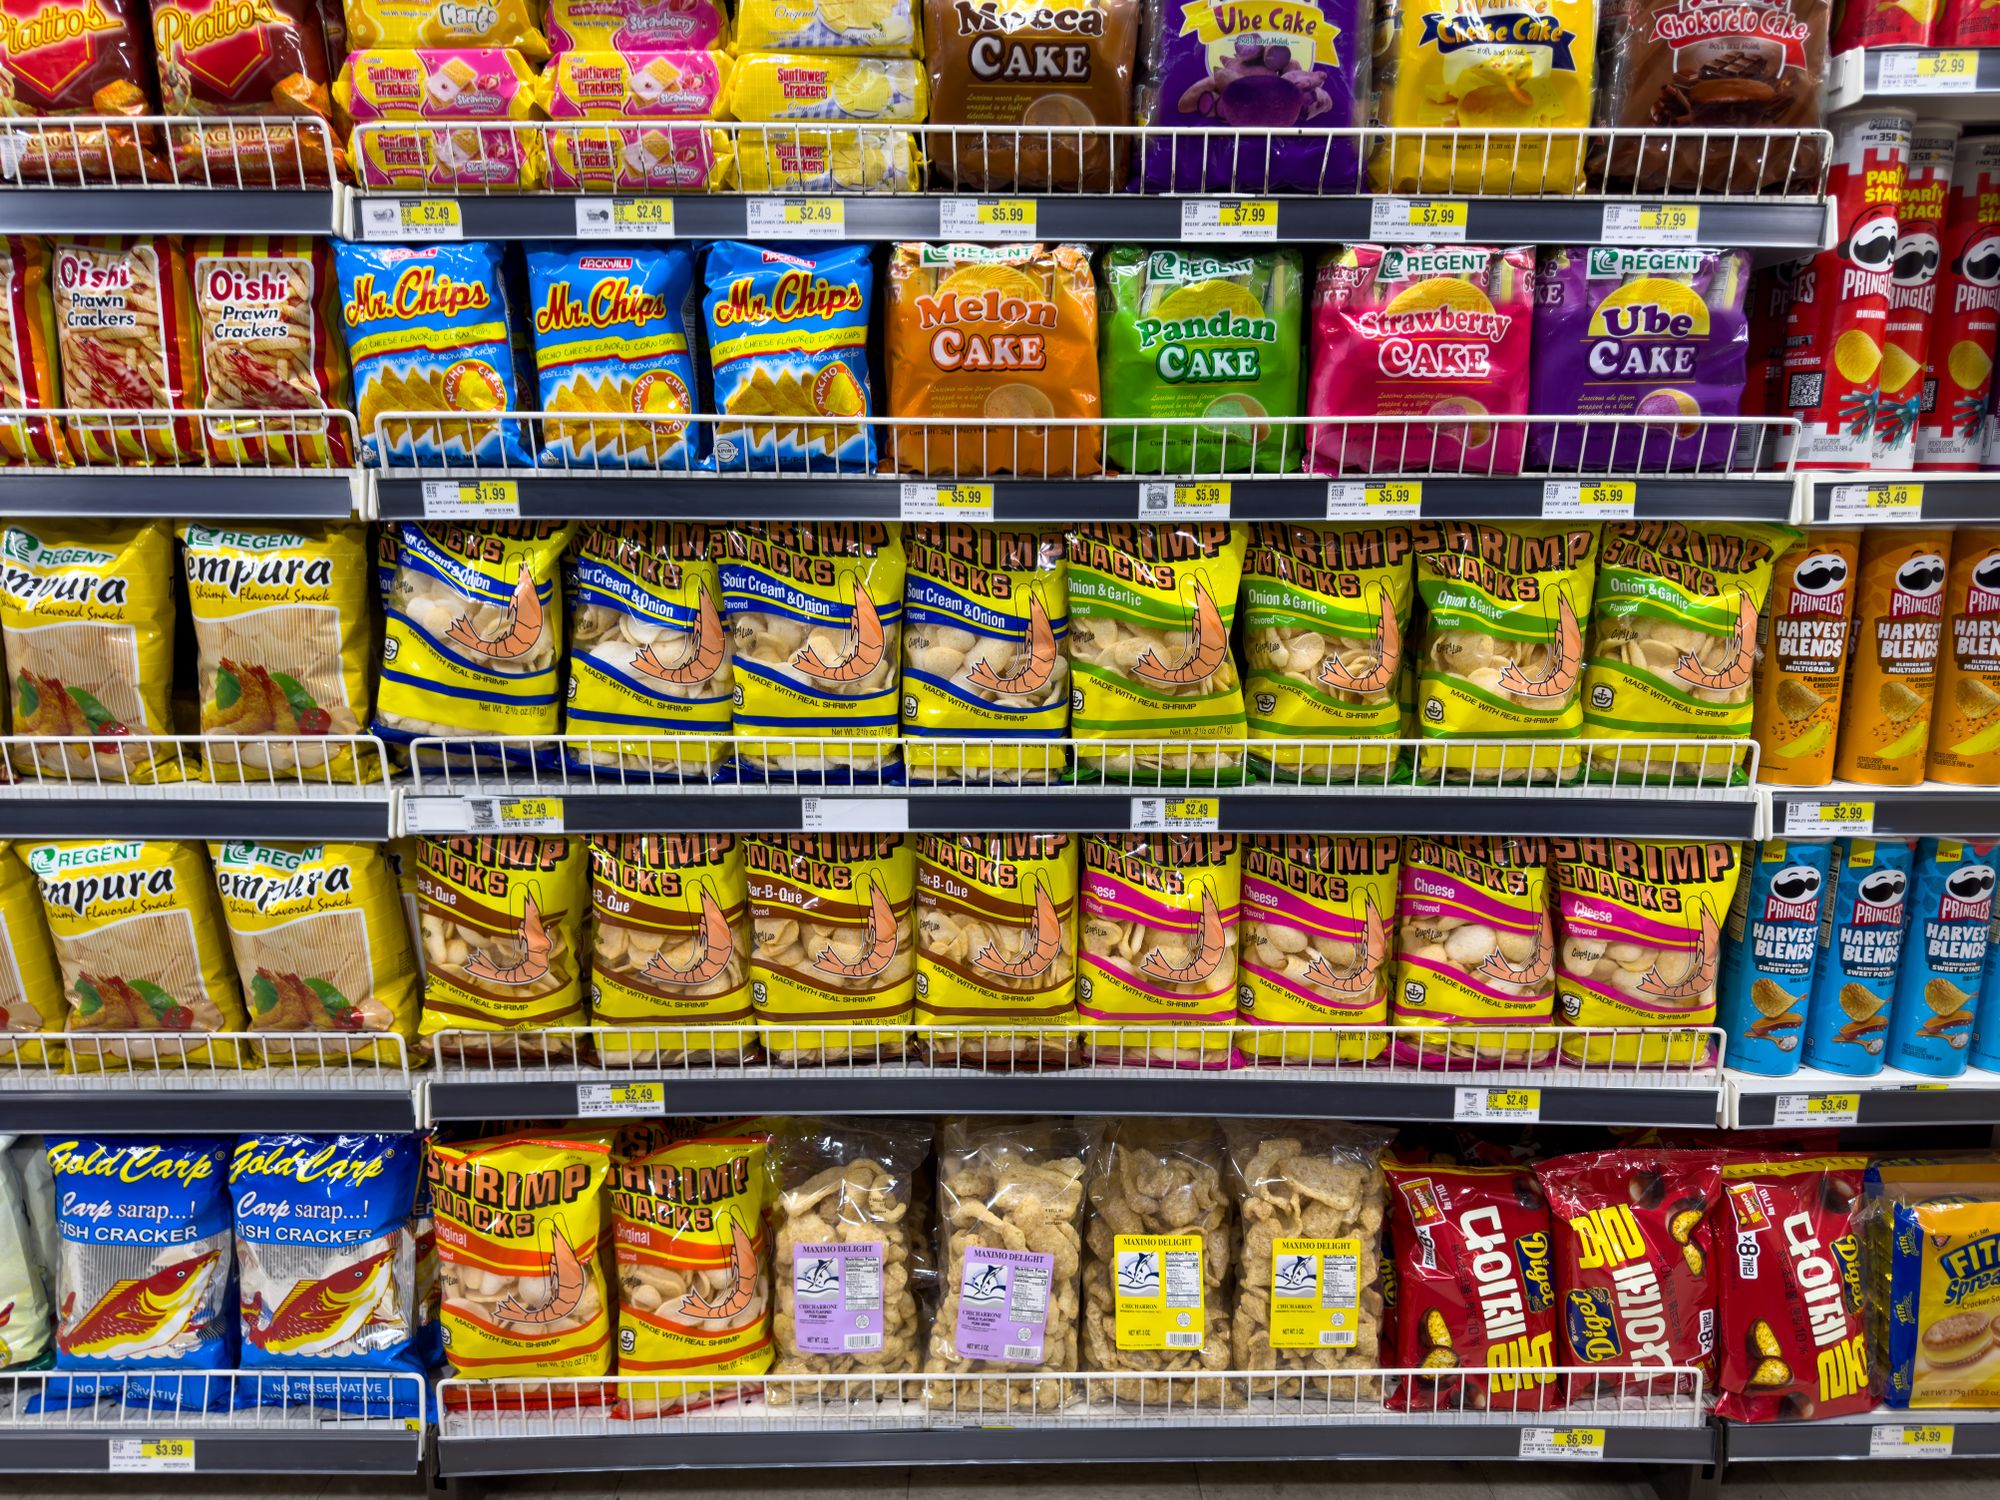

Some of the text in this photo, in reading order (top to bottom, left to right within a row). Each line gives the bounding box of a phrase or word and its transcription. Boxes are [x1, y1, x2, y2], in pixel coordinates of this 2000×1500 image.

[440, 3, 499, 34] Mango
[774, 6, 818, 20] Original
[956, 2, 1104, 37] Mocca
[1216, 4, 1318, 36] Ube Cake
[155, 0, 293, 61] Piattos
[629, 12, 697, 36] Strawberry
[1513, 17, 1564, 42] Cake
[1656, 8, 1810, 40] Chokoreto Cake
[969, 36, 1091, 82] CAKE
[1932, 59, 1965, 74] $2.99
[367, 65, 420, 83] Sunflower
[571, 66, 622, 82] Sunflower
[776, 67, 828, 83] Sunflower
[375, 80, 421, 98] Crackers
[578, 81, 624, 97] Crackers
[783, 82, 828, 98] Crackers
[456, 93, 503, 109] Strawberry
[424, 205, 450, 221] $2.49
[636, 204, 662, 219] $2.49
[800, 206, 832, 222] $2.49
[992, 207, 1024, 222] $5.99
[1234, 208, 1266, 223] $7.99
[1423, 209, 1454, 224] $7.99
[1655, 213, 1686, 228] $7.99
[953, 246, 1034, 262] REGENT
[59, 256, 131, 290] Oishi
[1180, 260, 1254, 279] REGENT
[1406, 255, 1489, 277] REGENT
[1622, 254, 1702, 276] REGENT
[210, 268, 289, 302] Oishi
[72, 293, 124, 310] Prawn
[344, 265, 491, 327] Mr. Chips
[536, 277, 667, 333] Mr. Chips
[713, 269, 863, 327] Mr. Chips
[67, 310, 135, 329] Crackers
[223, 305, 279, 322] Prawn
[915, 289, 1059, 331] Melon
[1135, 309, 1277, 350] Pandan
[1357, 305, 1513, 343] Strawberry
[1601, 303, 1695, 339] Ube
[214, 323, 288, 343] Crackers
[930, 328, 1047, 374] CAKE
[1377, 337, 1490, 378] CAKE
[1587, 337, 1696, 384] CAKE
[1155, 341, 1260, 387] CAKE
[446, 365, 466, 404] NACHO
[475, 488, 506, 502] $1.99
[951, 489, 981, 504] $5.99
[1195, 488, 1220, 503] $5.99
[1379, 489, 1409, 504] $5.99
[1592, 490, 1623, 504] $5.99
[1876, 492, 1908, 508] $3.49
[219, 533, 303, 550] REGENT
[1411, 520, 1594, 575] SHRIMP
[38, 551, 114, 568] REGENT
[1604, 541, 1719, 598] SNACKS
[195, 583, 330, 602] Shrimp Flavored Snack
[722, 571, 748, 591] Sour
[748, 575, 785, 599] Cream
[1248, 588, 1281, 606] Onion
[1292, 595, 1328, 615] Garlic
[1610, 601, 1639, 614] Flavored
[1791, 592, 1846, 616] PRINGLES
[1893, 592, 1941, 616] PRINGLES
[1776, 619, 1848, 639] HARVEST
[1878, 621, 1942, 640] HARVEST
[1779, 638, 1843, 658] BLENDS
[1881, 638, 1939, 658] BLENDS
[1785, 664, 1836, 674] MULTIGRAINS
[1449, 688, 1559, 725] MADE WITH REAL SHRIMP
[522, 802, 546, 818] $2.49
[1185, 803, 1209, 818] $2.49
[1833, 807, 1862, 820] $2.99
[58, 842, 140, 869] REGENT
[1556, 838, 1735, 894] SHRIMP
[1413, 877, 1455, 899] Cheese
[86, 897, 176, 920] Flavored Snack
[1412, 901, 1440, 915] Flavored
[1767, 897, 1817, 922] PRINGLES
[1752, 922, 1820, 944] HARVEST
[1754, 940, 1814, 961] BLENDS
[1757, 963, 1810, 975] SWEET POTATO
[1258, 978, 1364, 1018] MADE WITH REAL SHRIMP
[624, 1087, 653, 1101] $2.49
[1506, 1093, 1529, 1107] $2.49
[1820, 1099, 1848, 1112] $3.49
[119, 1144, 214, 1188] Carp
[426, 1155, 593, 1218] SHRIMP
[61, 1190, 113, 1220] Carp
[94, 1224, 198, 1245] CRACKER
[1122, 1238, 1193, 1247] MAXIMO DELIGHT
[802, 1244, 873, 1254] MAXIMO DELIGHT
[1949, 1237, 2000, 1279] FIT
[1519, 1231, 1556, 1307] Diget
[272, 1381, 383, 1395] NO PRESERVATIVE
[1565, 1433, 1594, 1446] $6.99
[1914, 1431, 1941, 1443] $4.99
[156, 1443, 184, 1457] $3.99
